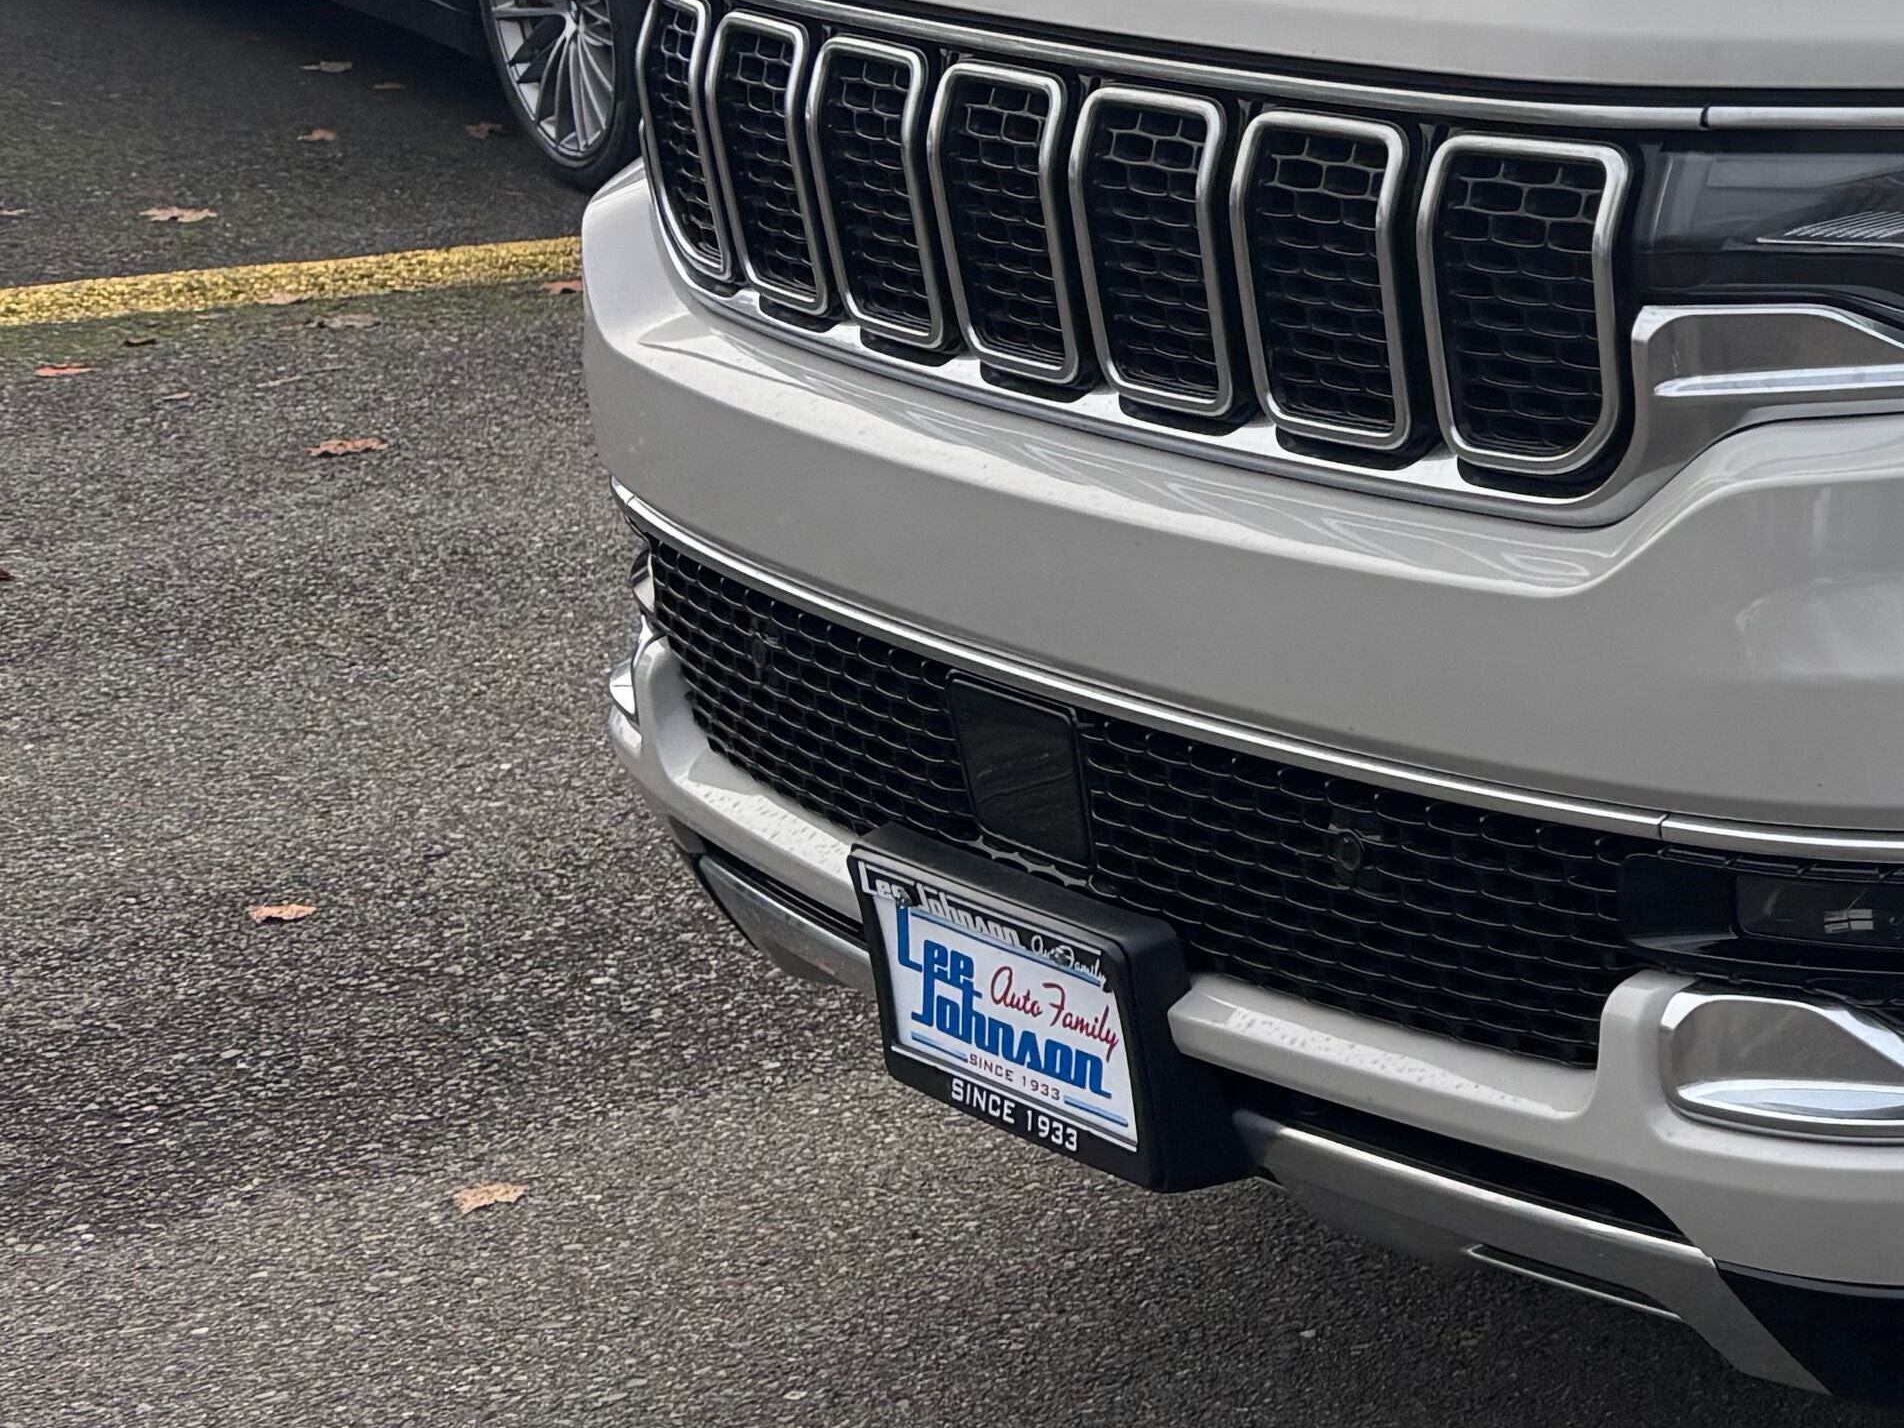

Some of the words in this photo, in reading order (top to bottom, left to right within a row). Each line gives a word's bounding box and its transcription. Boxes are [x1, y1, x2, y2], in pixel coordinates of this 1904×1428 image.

[896, 905, 982, 999] Lee
[916, 882, 1027, 950] Johnson
[911, 970, 1112, 1100] Johnson
[990, 966, 1042, 1018] Auto
[1043, 982, 1120, 1063] Family
[951, 1077, 1016, 1124] SINCE
[1026, 1109, 1078, 1153] 1933
[968, 1053, 1015, 1083] SINCE
[1022, 1075, 1061, 1102] 1933
